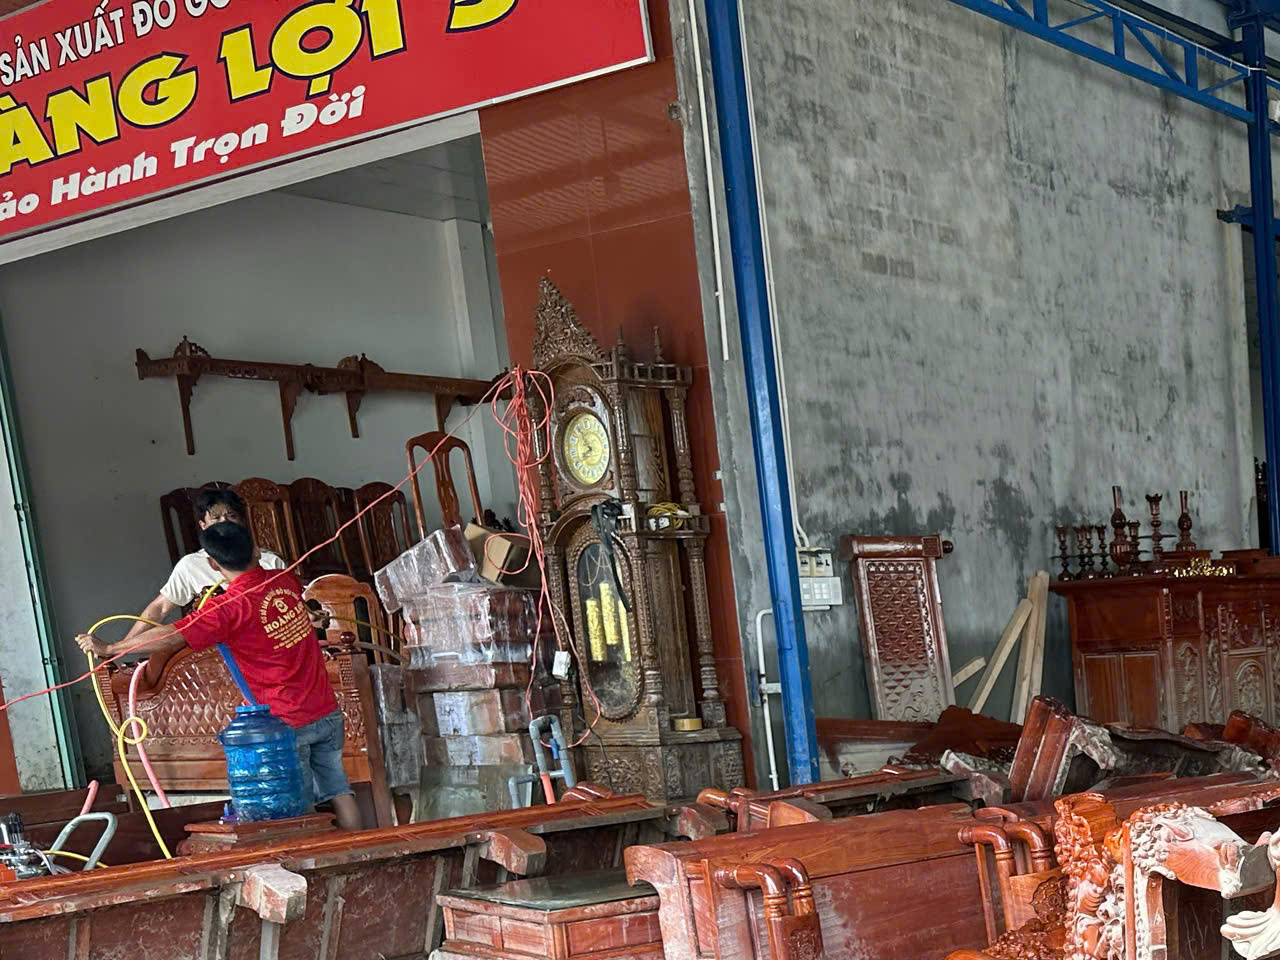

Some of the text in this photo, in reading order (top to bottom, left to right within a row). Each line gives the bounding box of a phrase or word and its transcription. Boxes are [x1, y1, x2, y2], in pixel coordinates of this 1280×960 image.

[0, 35, 50, 86] SẢN
[54, 0, 124, 67] XUẤT
[51, 151, 158, 206] Hành
[170, 122, 269, 168] Trọn
[281, 85, 366, 137] Đời
[264, 610, 296, 633] HOÀNG
